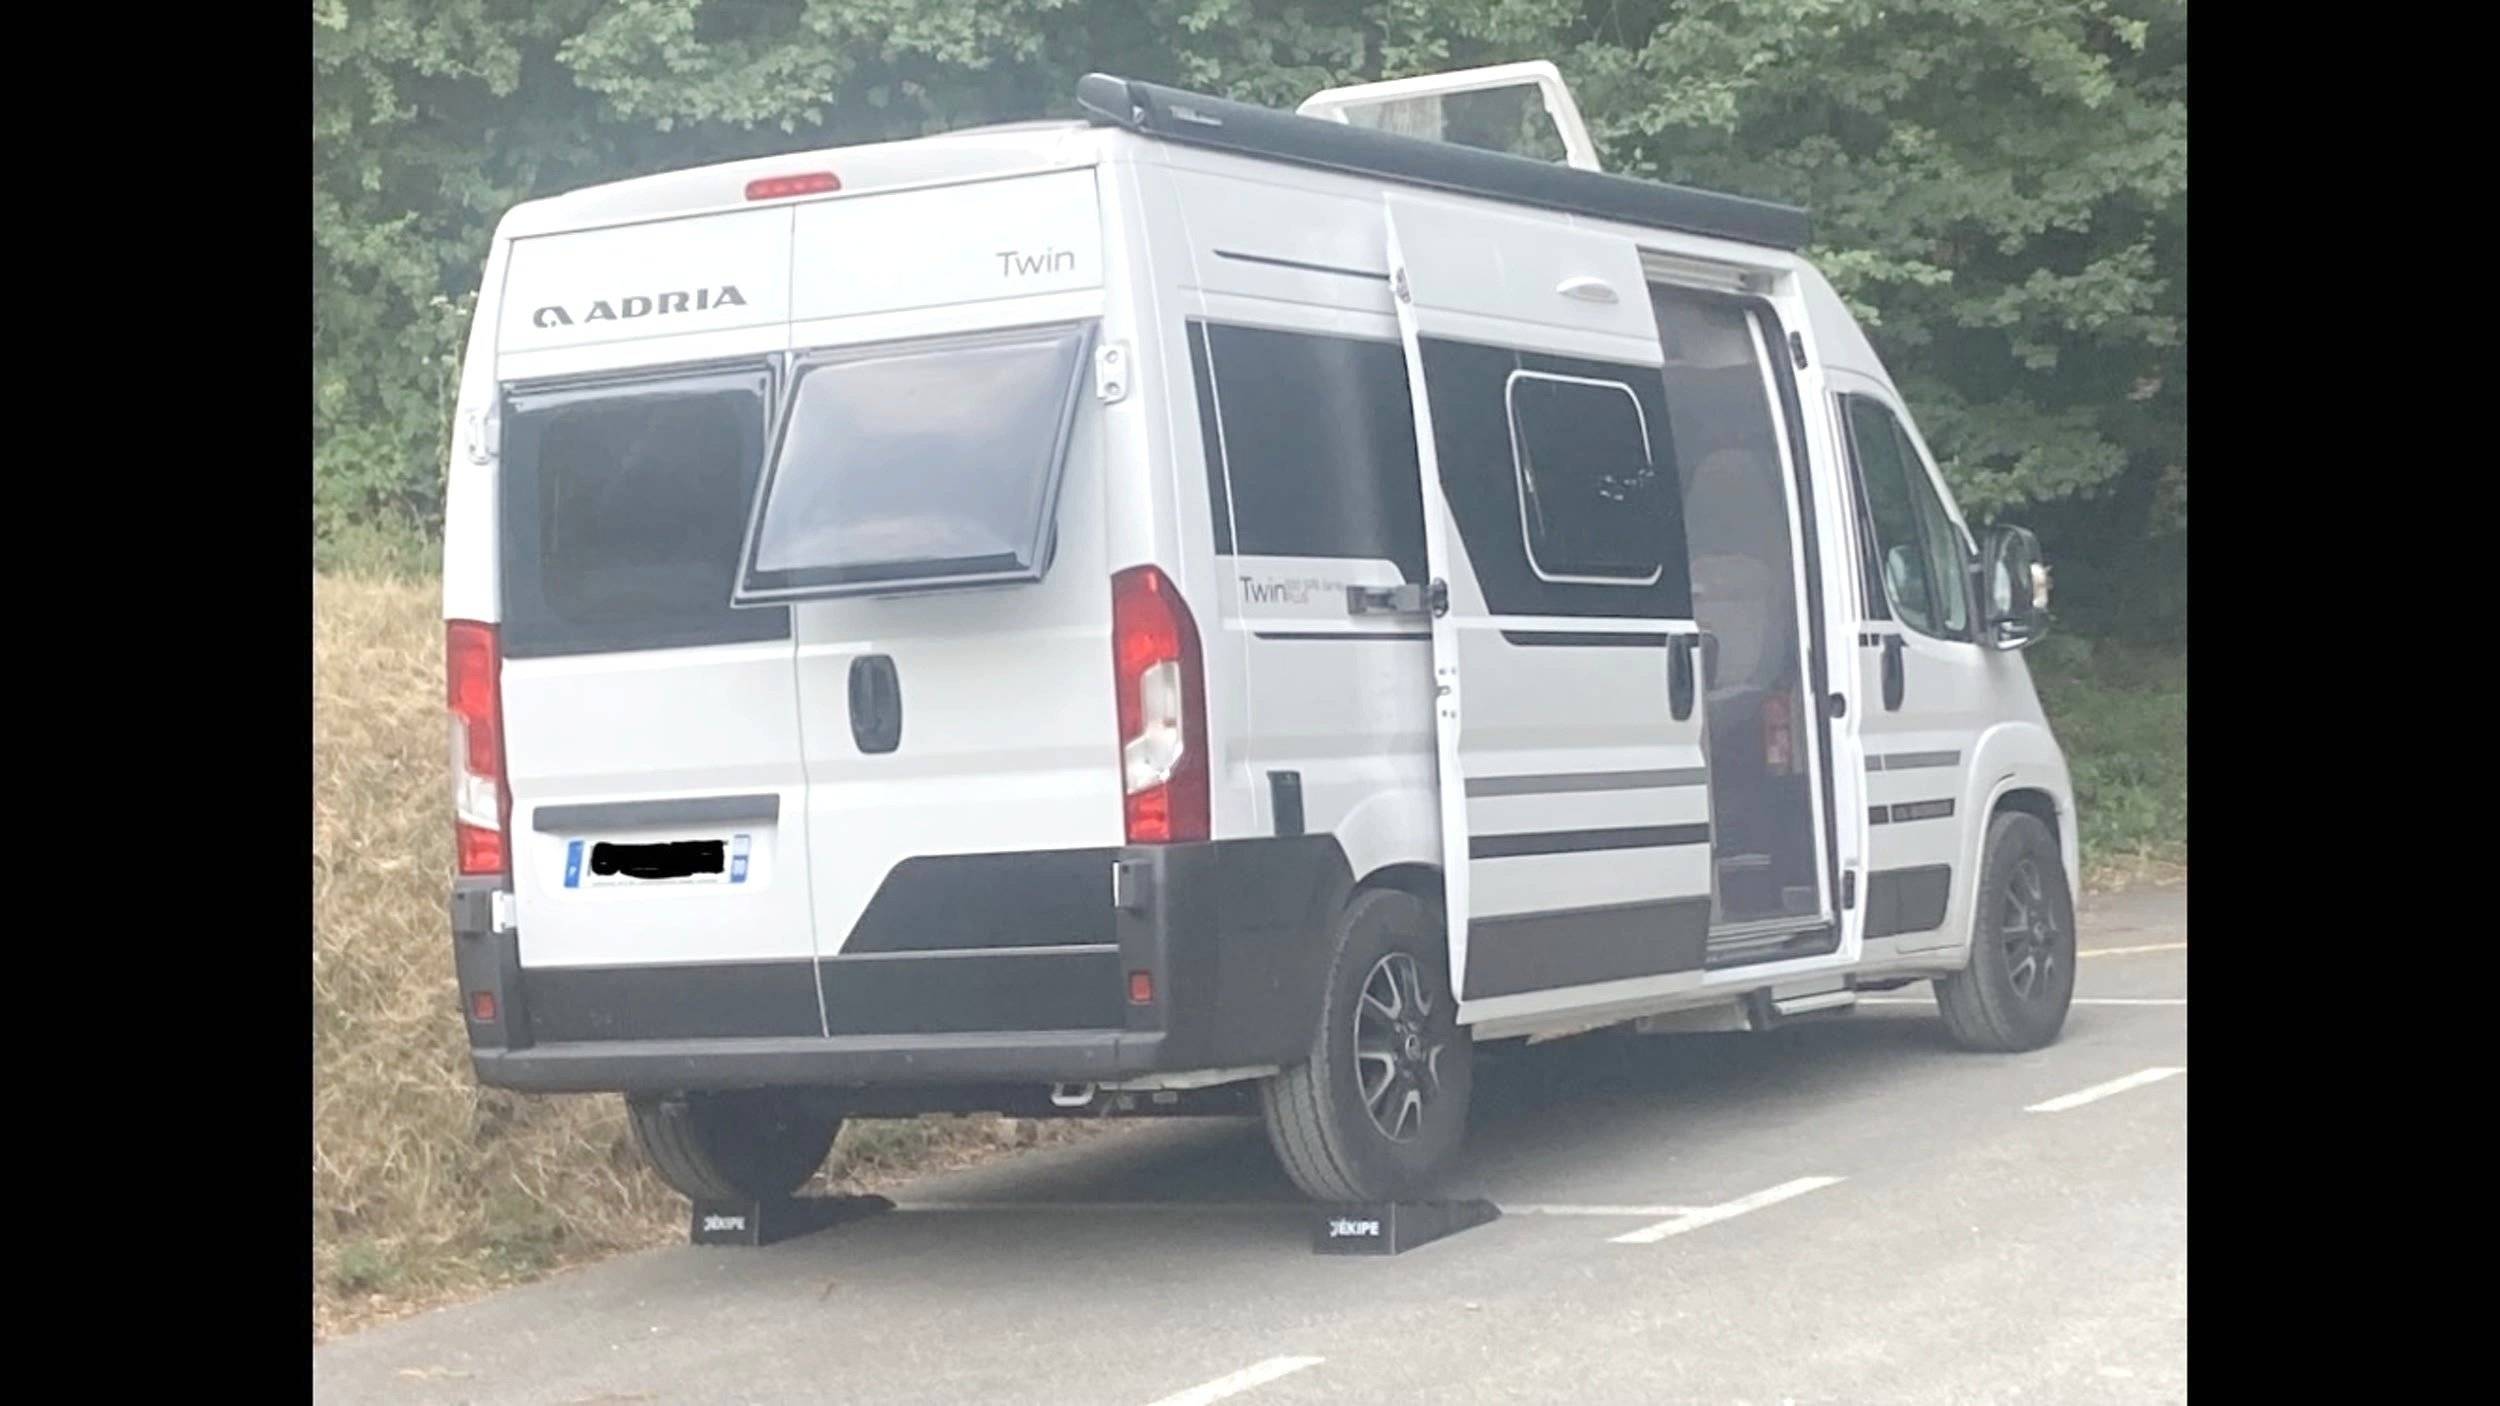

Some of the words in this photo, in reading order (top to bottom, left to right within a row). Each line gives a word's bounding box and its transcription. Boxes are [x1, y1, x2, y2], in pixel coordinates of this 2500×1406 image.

[995, 246, 1075, 277] Twin
[584, 285, 747, 323] ADRIA
[1239, 576, 1287, 603] Twin
